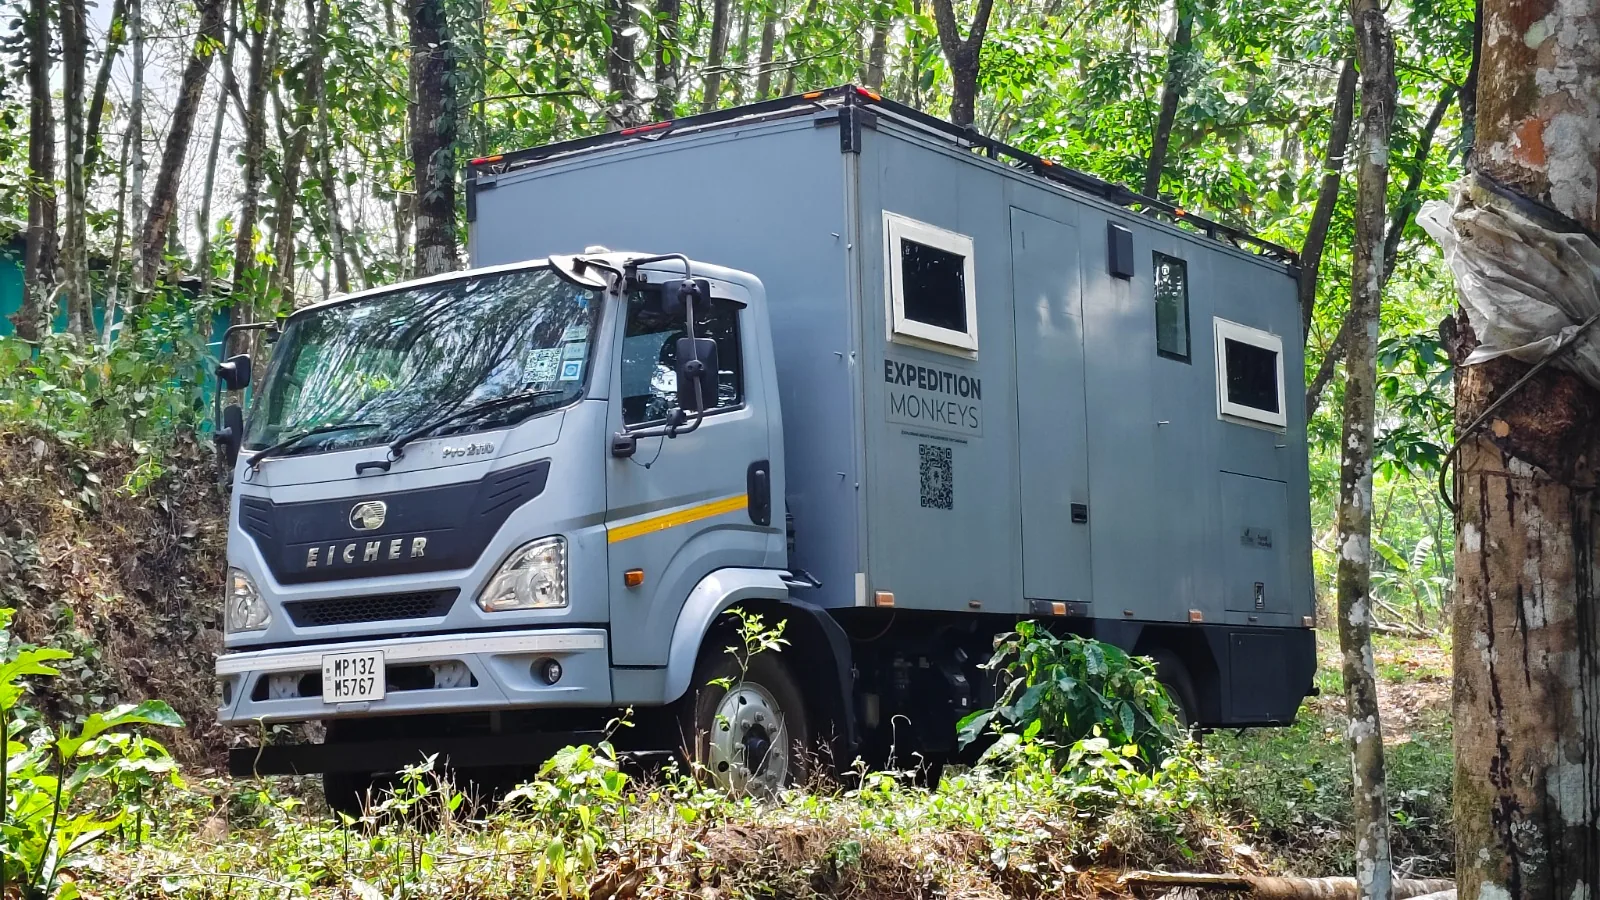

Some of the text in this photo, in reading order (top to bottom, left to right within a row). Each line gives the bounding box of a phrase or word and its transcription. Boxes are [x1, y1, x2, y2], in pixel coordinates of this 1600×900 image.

[884, 359, 981, 401] EXPEDITION
[890, 392, 979, 429] MONKEYS
[442, 446, 466, 459] Pro
[306, 537, 428, 568] EICHER
[334, 657, 375, 677] MP13Z
[334, 677, 375, 697] M5767
